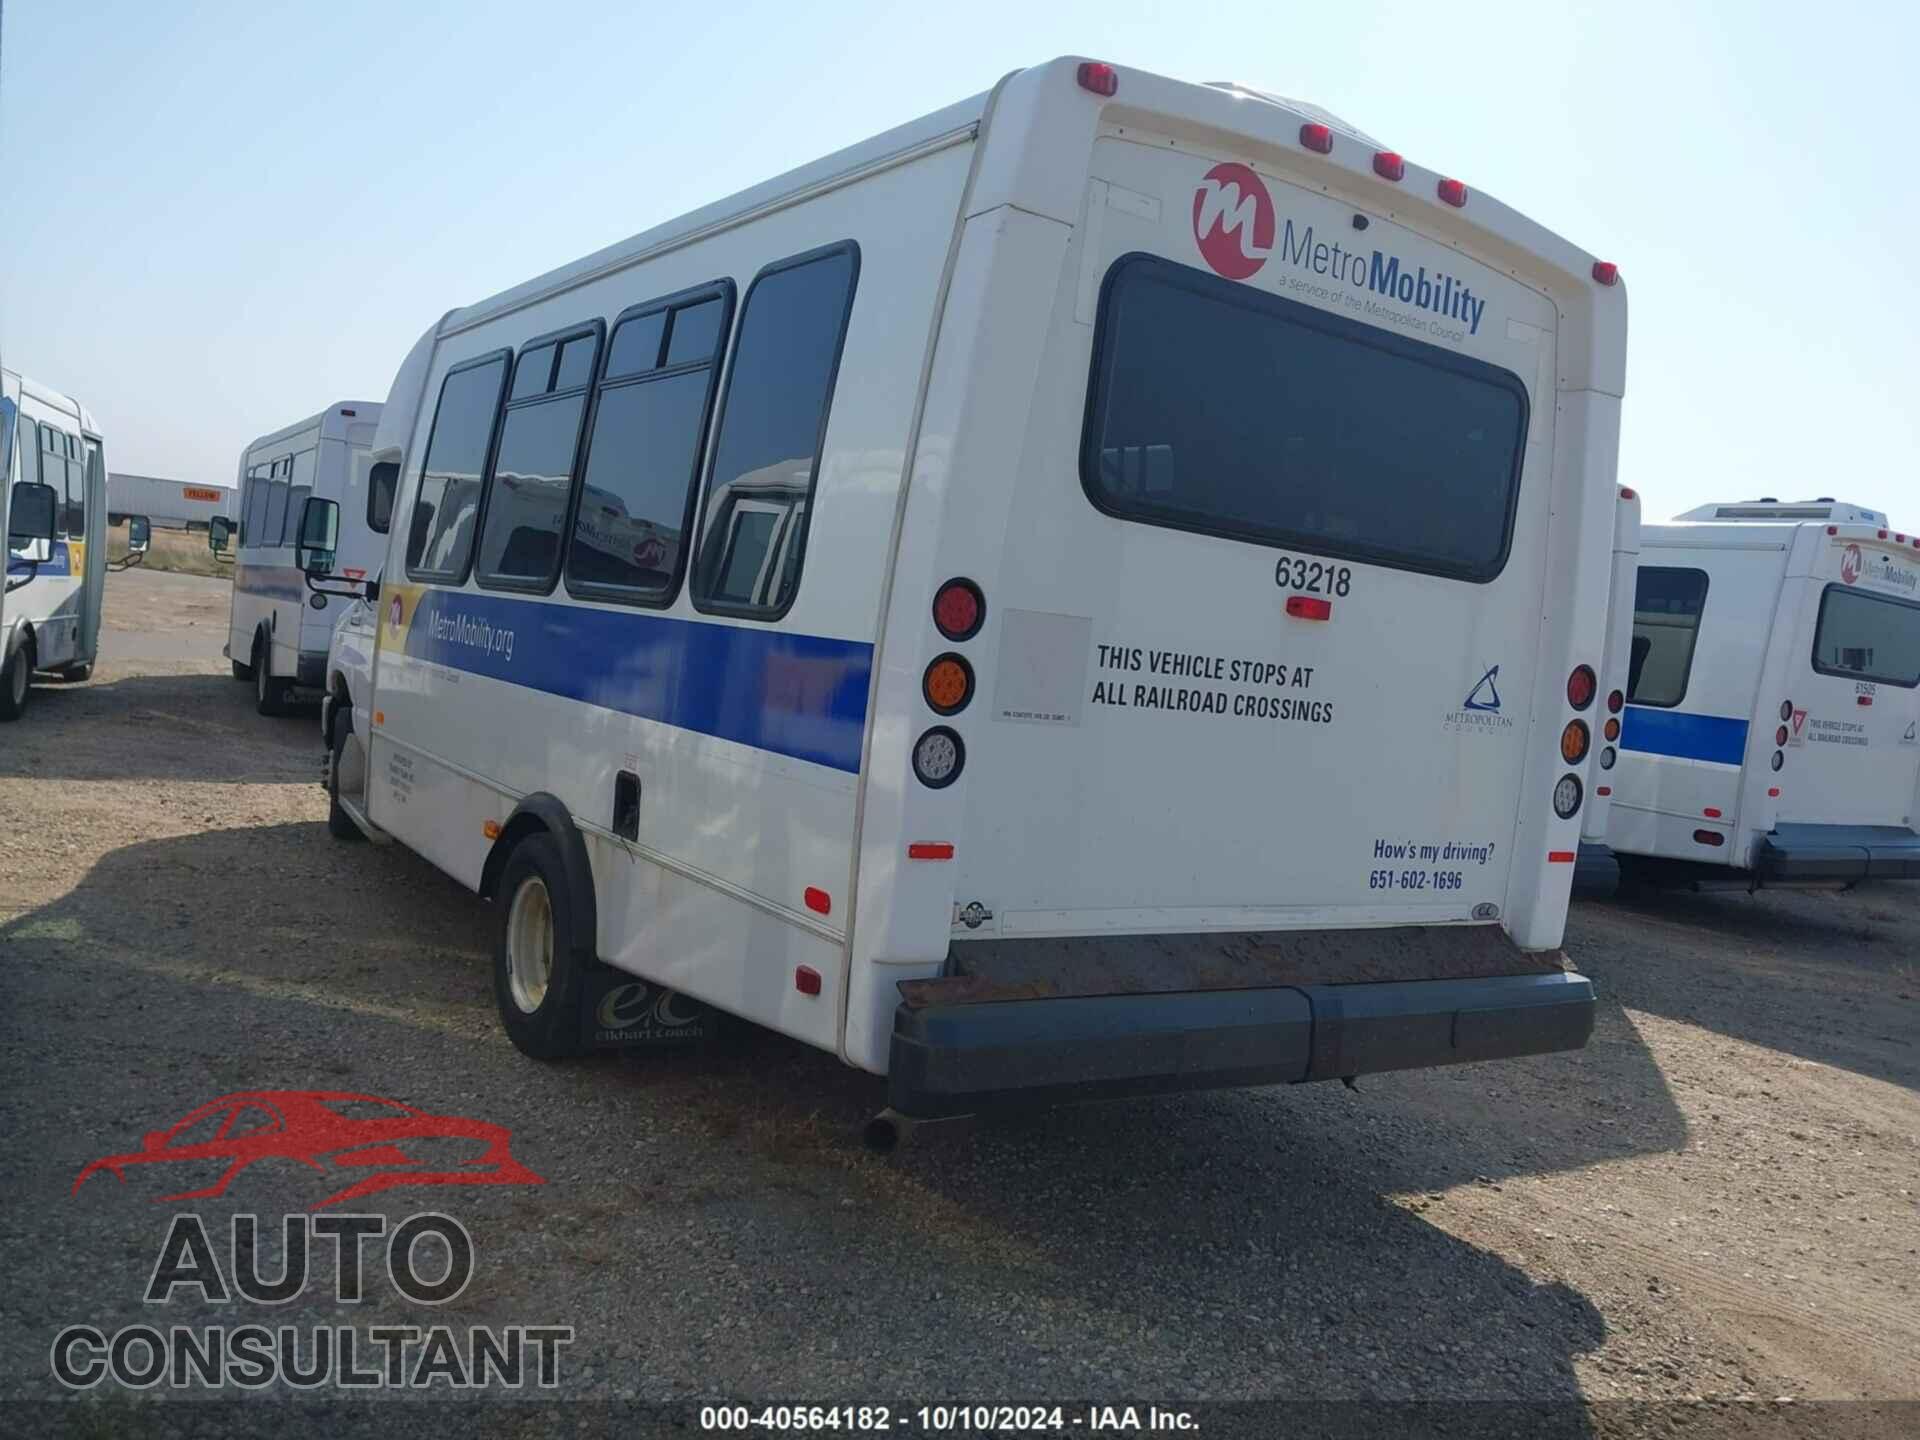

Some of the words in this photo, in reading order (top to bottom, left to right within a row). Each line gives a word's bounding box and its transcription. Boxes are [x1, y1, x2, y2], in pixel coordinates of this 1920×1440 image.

[1282, 219, 1485, 335] MetroMobility
[1279, 276, 1287, 286] a
[1288, 277, 1330, 298] service
[1331, 290, 1345, 305] of
[1346, 295, 1361, 311] the
[1363, 300, 1427, 332] Metropolitan
[1429, 320, 1465, 343] Council
[1275, 556, 1351, 597] 63218
[428, 609, 514, 662] MetroMobility.org
[1097, 644, 1142, 671] THIS
[1149, 650, 1225, 680] VEHICLE
[1230, 659, 1287, 686] STOPS
[1291, 667, 1314, 688] AT
[1092, 681, 1128, 706] ALL
[1133, 685, 1227, 714] RAILROAD
[1233, 694, 1333, 723] CROSSINGS
[1445, 712, 1513, 728] METROPOLITAN
[1374, 839, 1416, 859] How's
[1420, 845, 1440, 864] my
[1442, 841, 1495, 865] driving?
[1369, 870, 1462, 889] 651-602-1696
